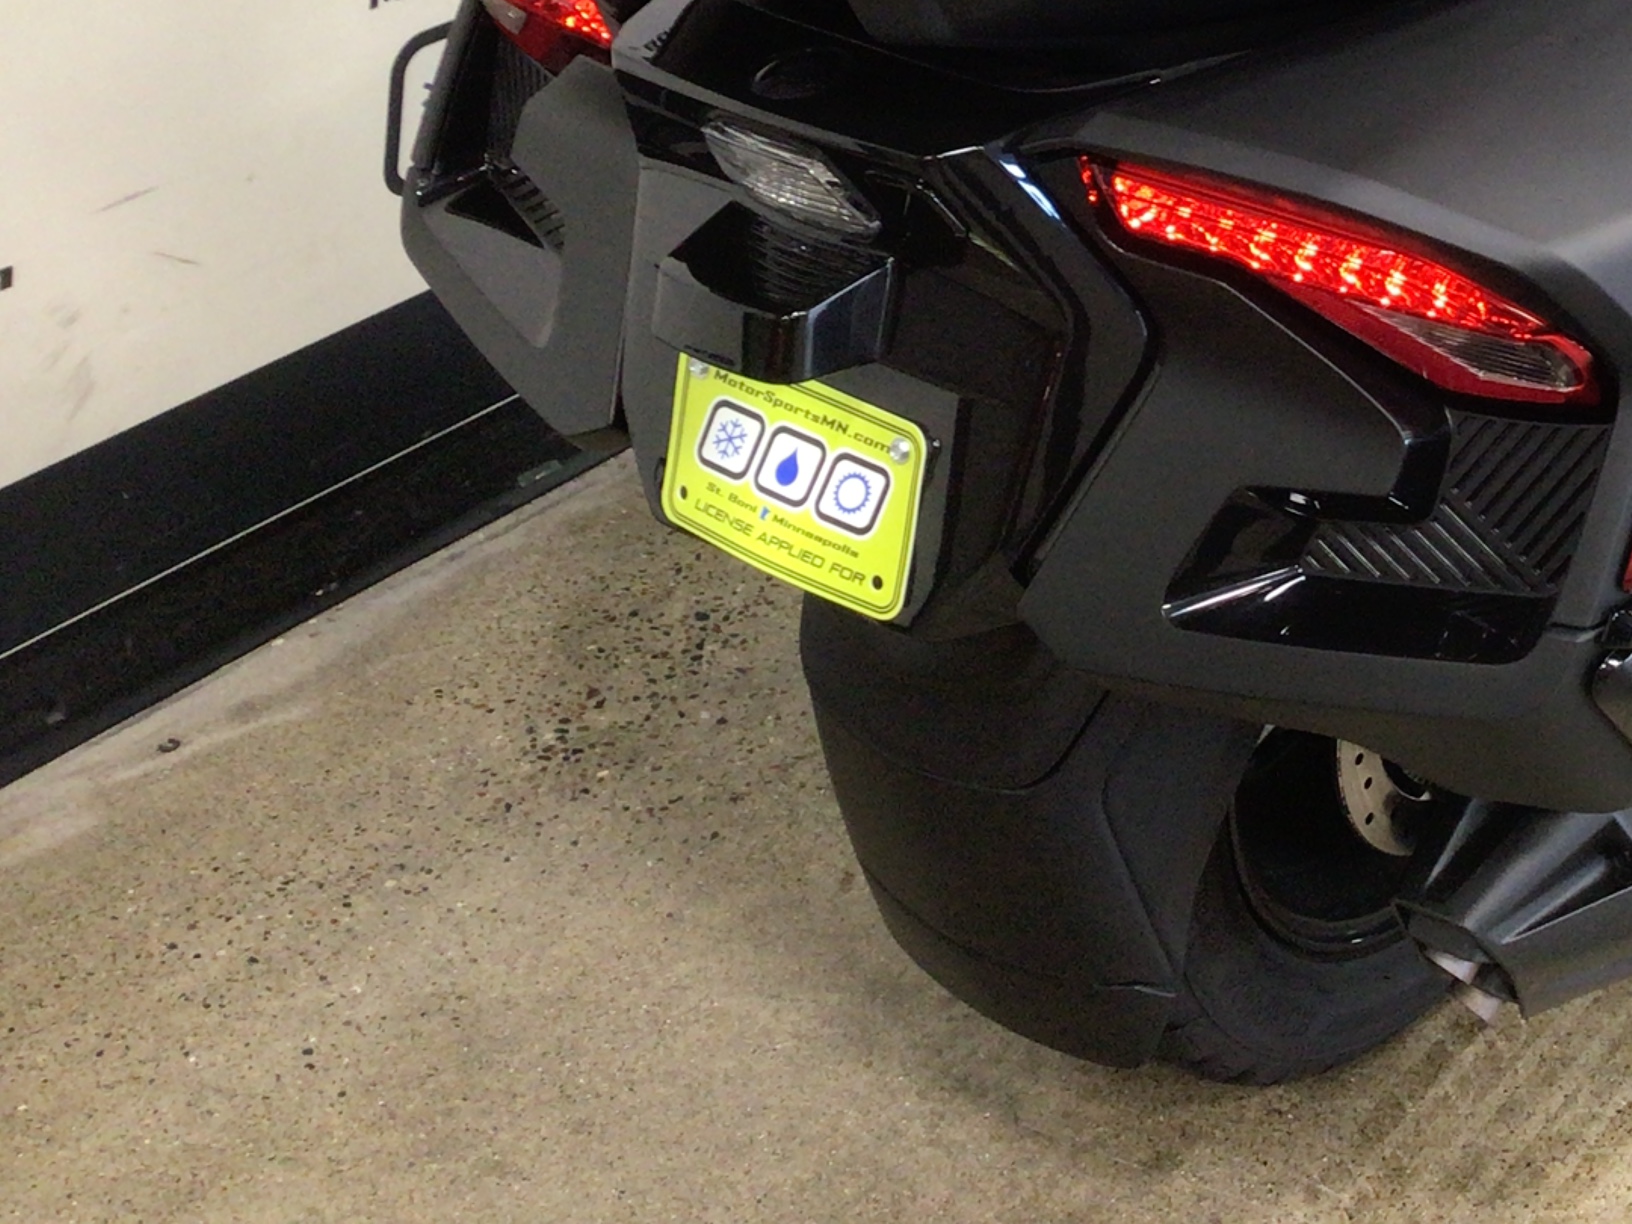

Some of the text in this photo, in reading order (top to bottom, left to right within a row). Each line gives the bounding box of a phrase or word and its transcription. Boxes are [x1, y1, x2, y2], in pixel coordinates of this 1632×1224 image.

[713, 369, 891, 454] MotorSportsMN.com
[694, 499, 867, 586] LICENSE APPLIED FOR
[705, 481, 860, 559] St. Boni Minneapolis
